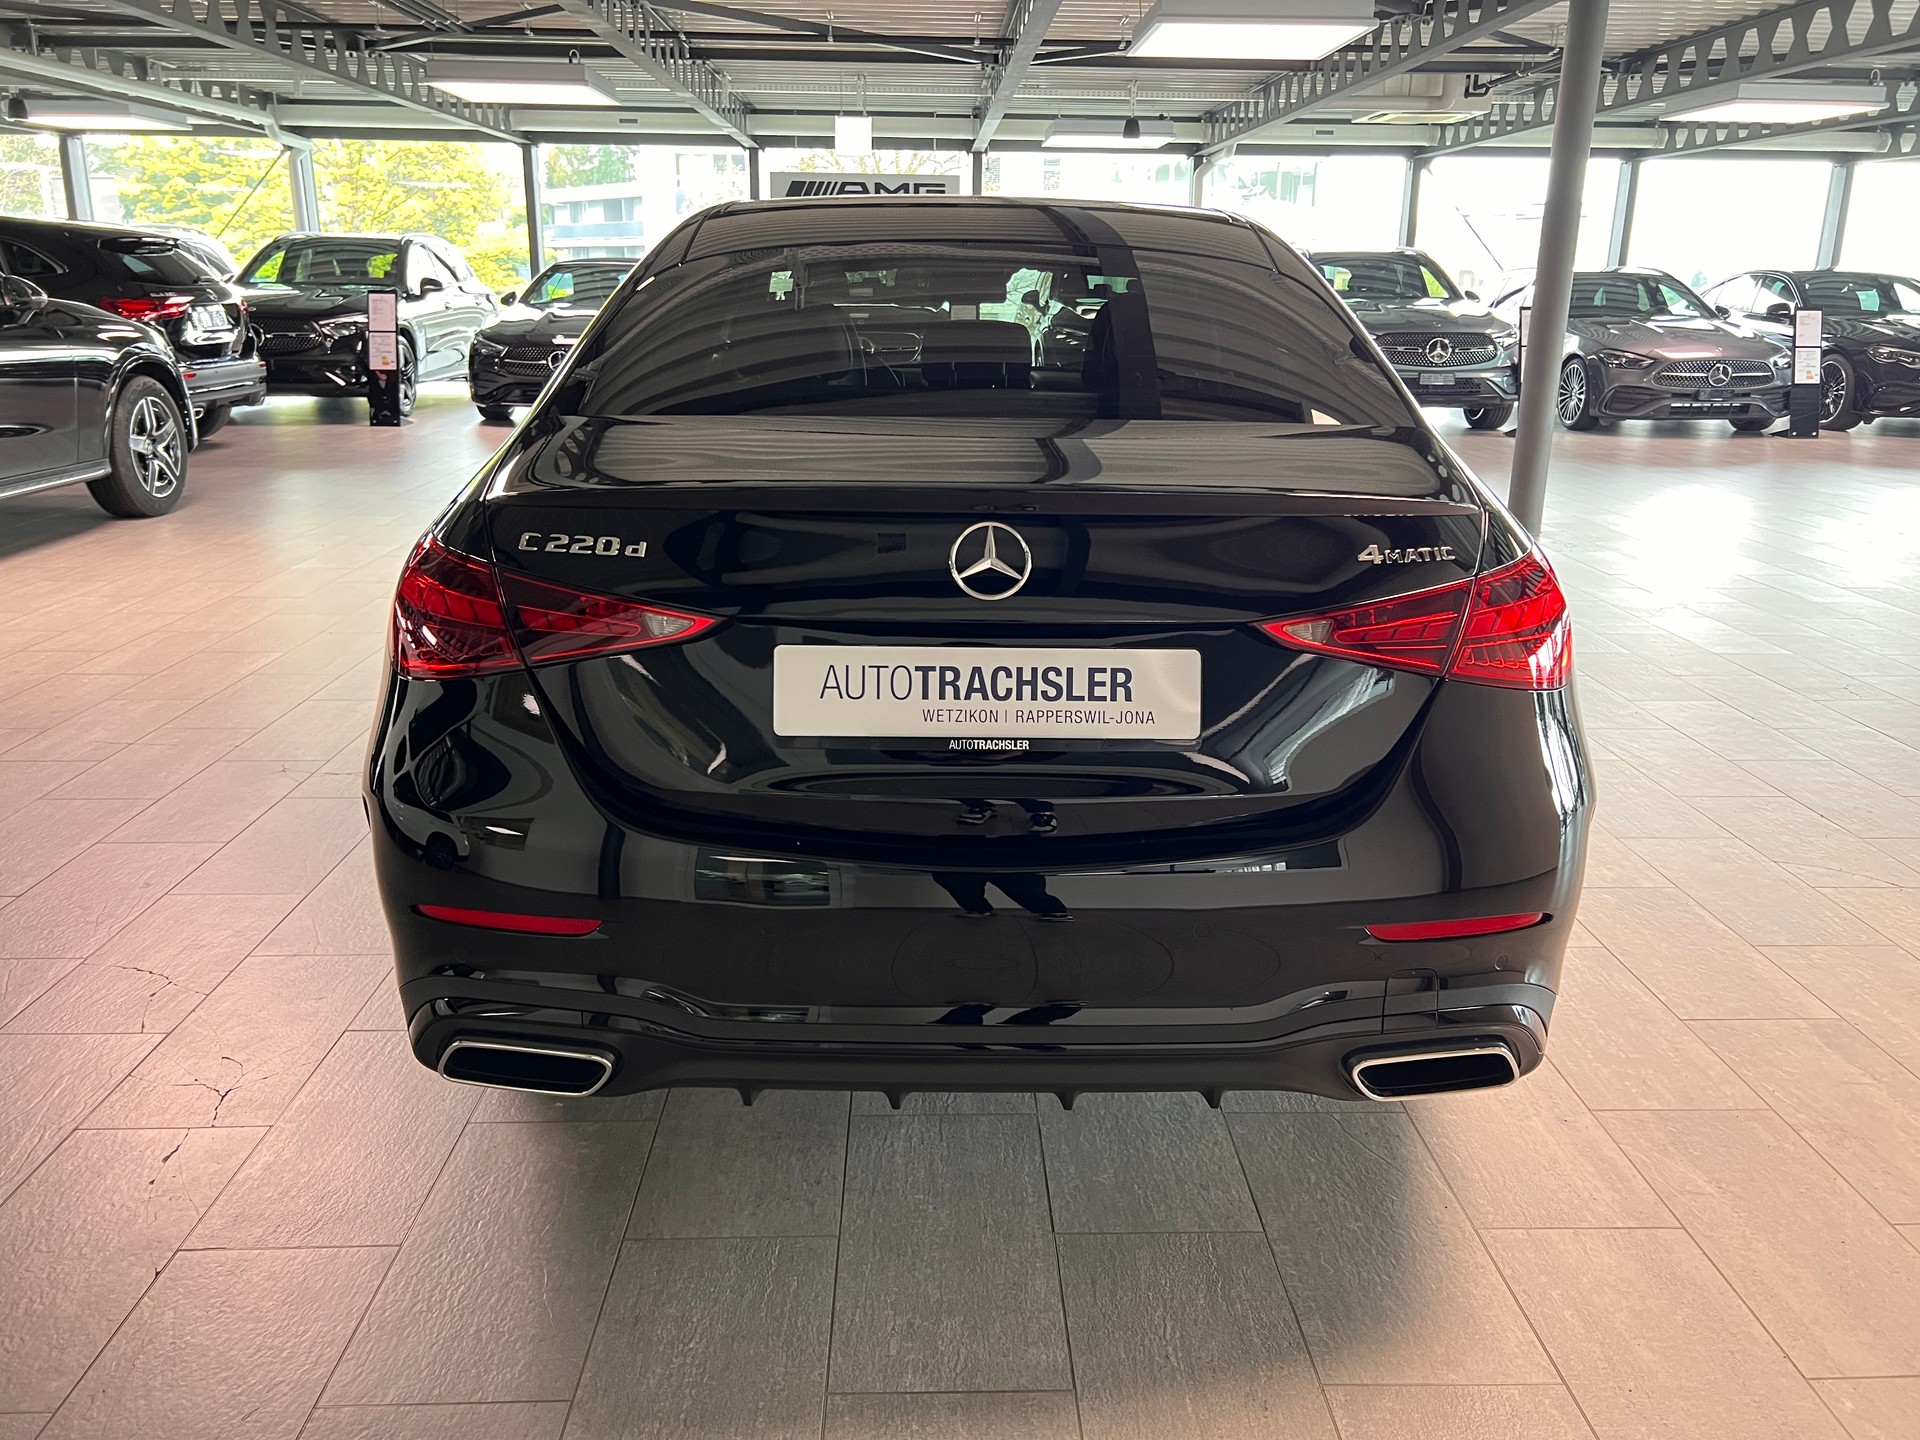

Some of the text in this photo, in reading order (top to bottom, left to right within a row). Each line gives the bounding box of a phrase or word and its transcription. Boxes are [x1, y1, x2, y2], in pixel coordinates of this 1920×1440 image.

[836, 181, 946, 195] AMG
[518, 532, 647, 558] C 220 d
[1357, 544, 1456, 565] 4MATIC
[819, 664, 1134, 703] AUTOTRACHSLER
[922, 708, 999, 724] WETZIKON
[1016, 709, 1156, 725] RAPPERSWIL-JONA
[948, 739, 1030, 750] AUTOTRACHSLER
